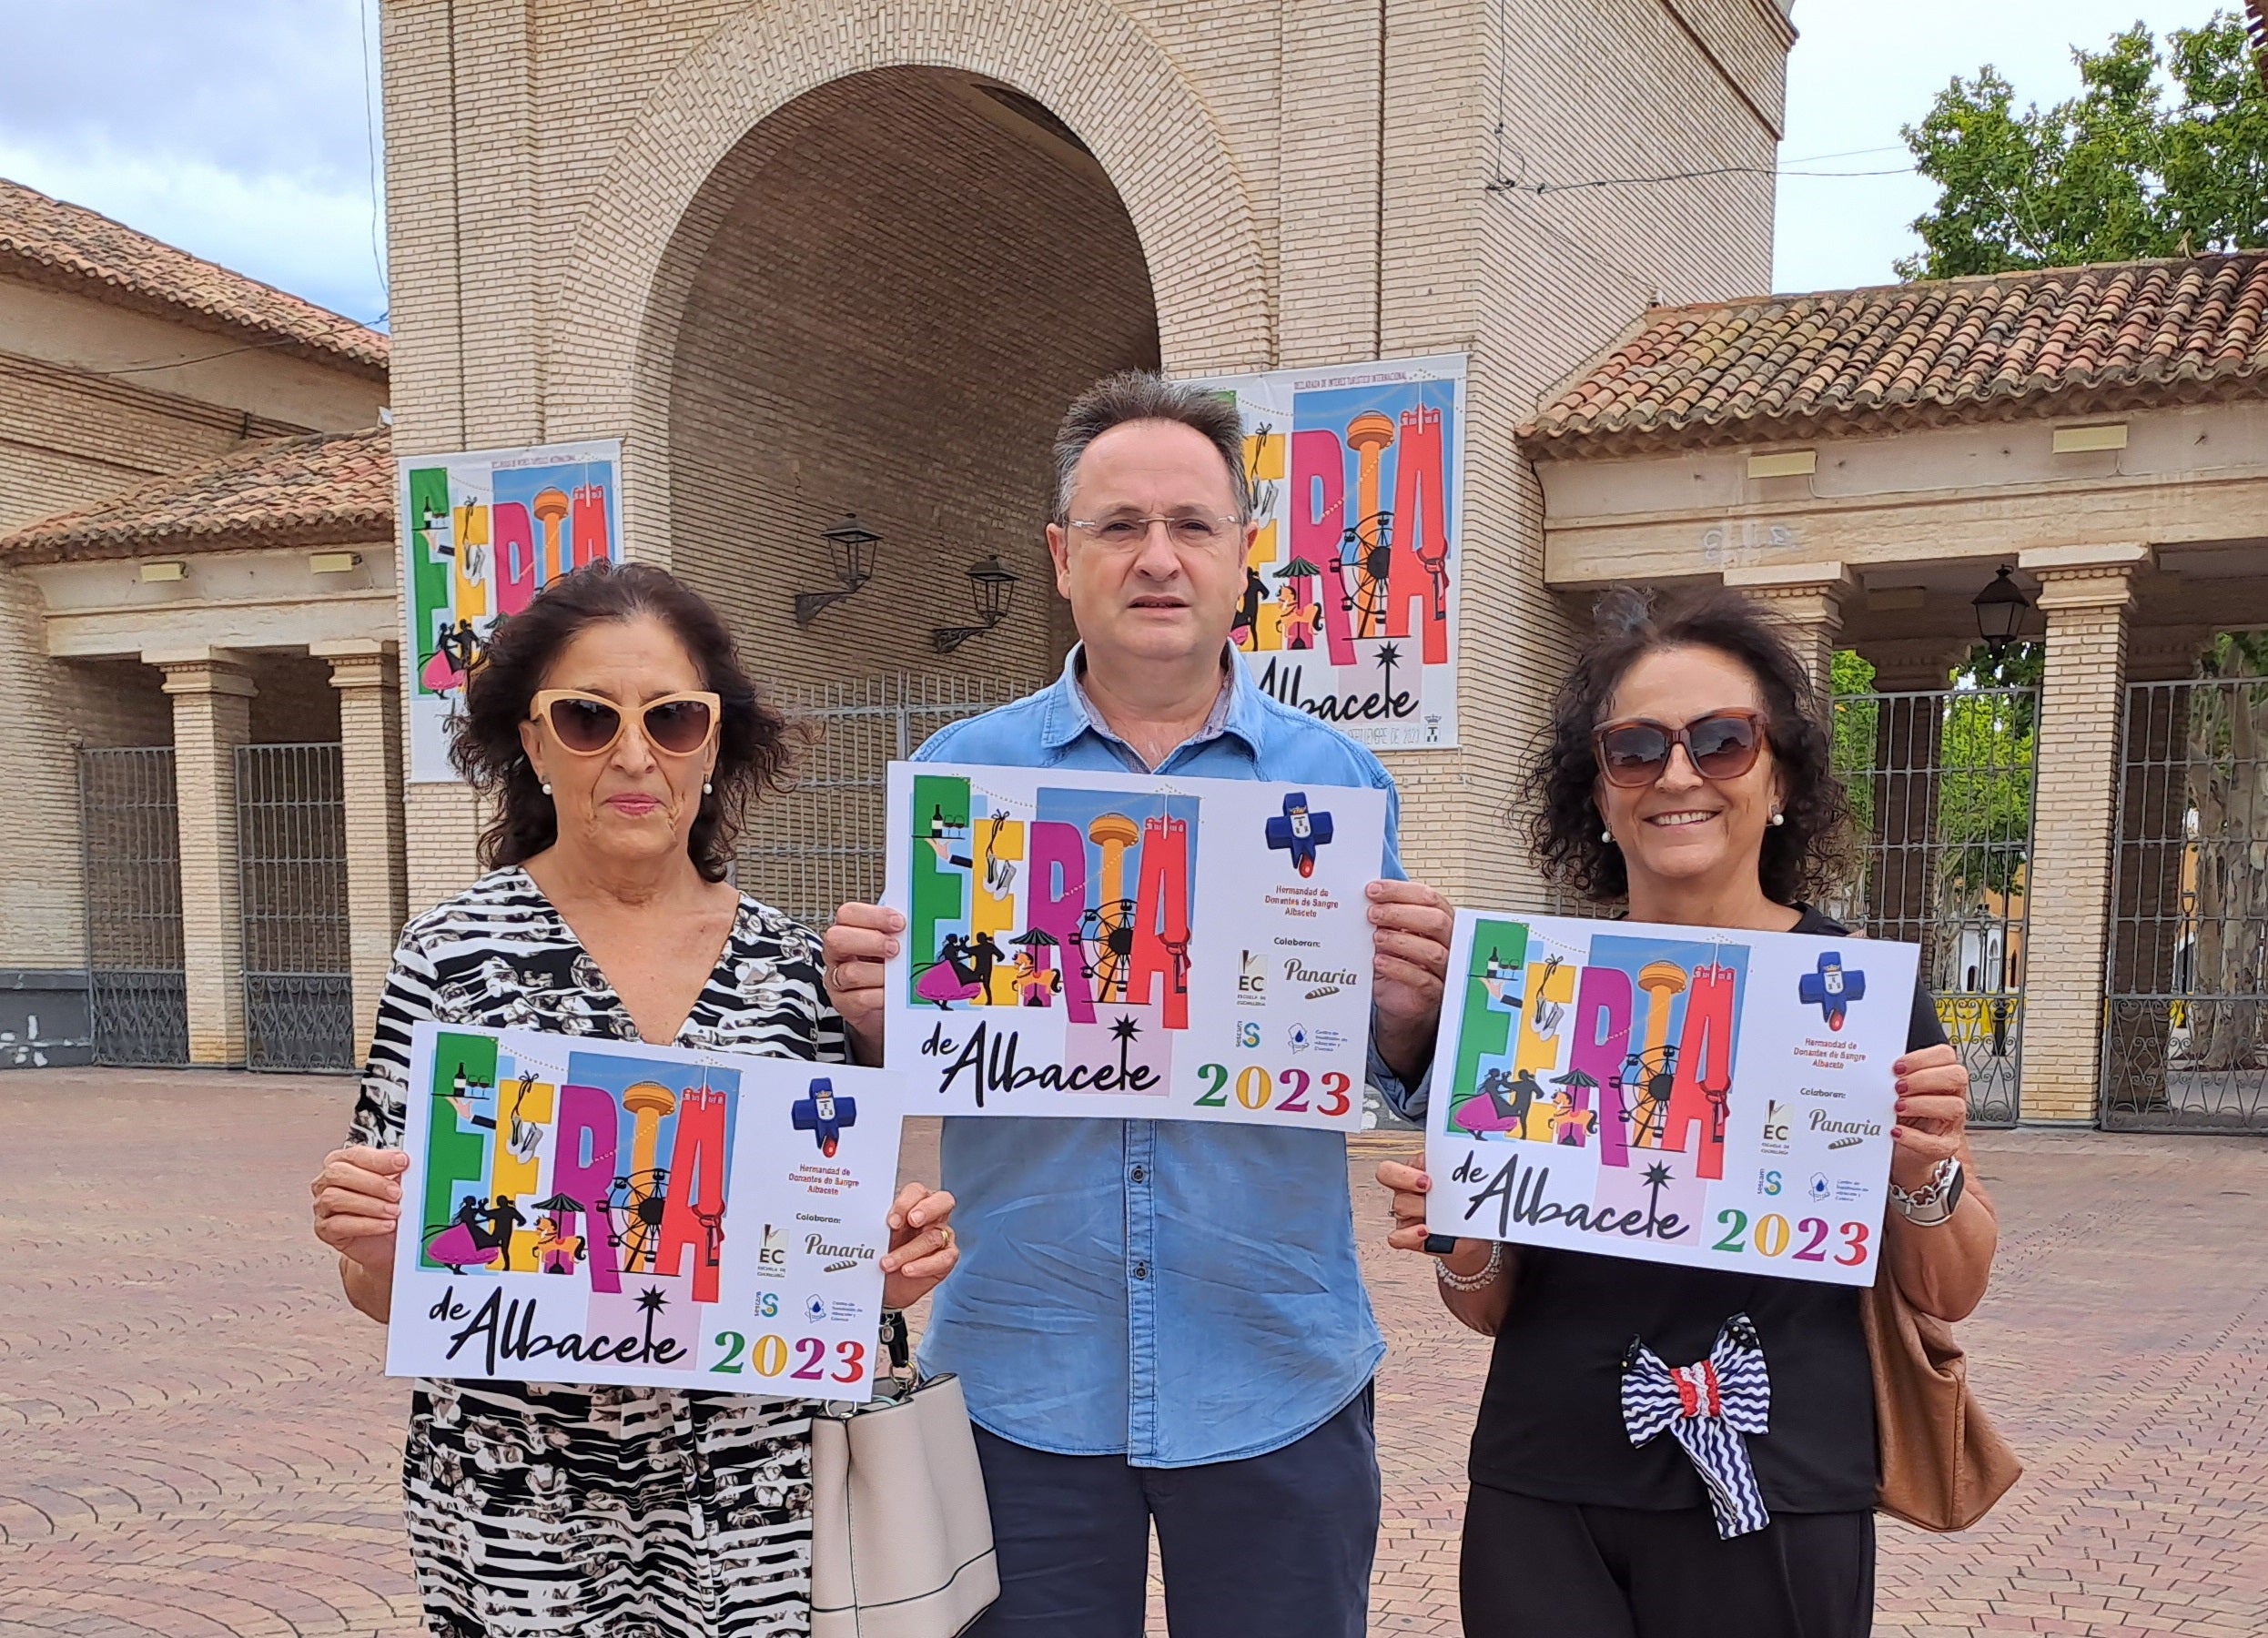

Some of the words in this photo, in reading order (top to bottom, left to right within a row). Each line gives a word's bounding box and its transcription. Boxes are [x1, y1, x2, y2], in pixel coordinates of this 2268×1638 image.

[910, 774, 1190, 1029] FERIA
[1301, 898, 1311, 906] de
[1320, 888, 1329, 897] de
[1239, 976, 1265, 992] EC
[1283, 958, 1357, 985] Panaria
[922, 1021, 958, 1057] de
[1446, 918, 1734, 1180] FERIA
[939, 1014, 1160, 1107] Albacete
[1194, 1063, 1351, 1117] 2023
[1764, 1125, 1788, 1140] EC
[1809, 1109, 1881, 1136] Panaria
[420, 1031, 725, 1302] FERIA
[825, 1176, 832, 1184] de
[1452, 1149, 1489, 1184] de
[1464, 1153, 1690, 1239] Albacete
[805, 1233, 876, 1259] Panaria
[1712, 1208, 1869, 1267] 2023
[759, 1249, 785, 1264] EC
[429, 1286, 471, 1321] de
[446, 1284, 687, 1376] Albacete
[709, 1330, 866, 1383] 2023
